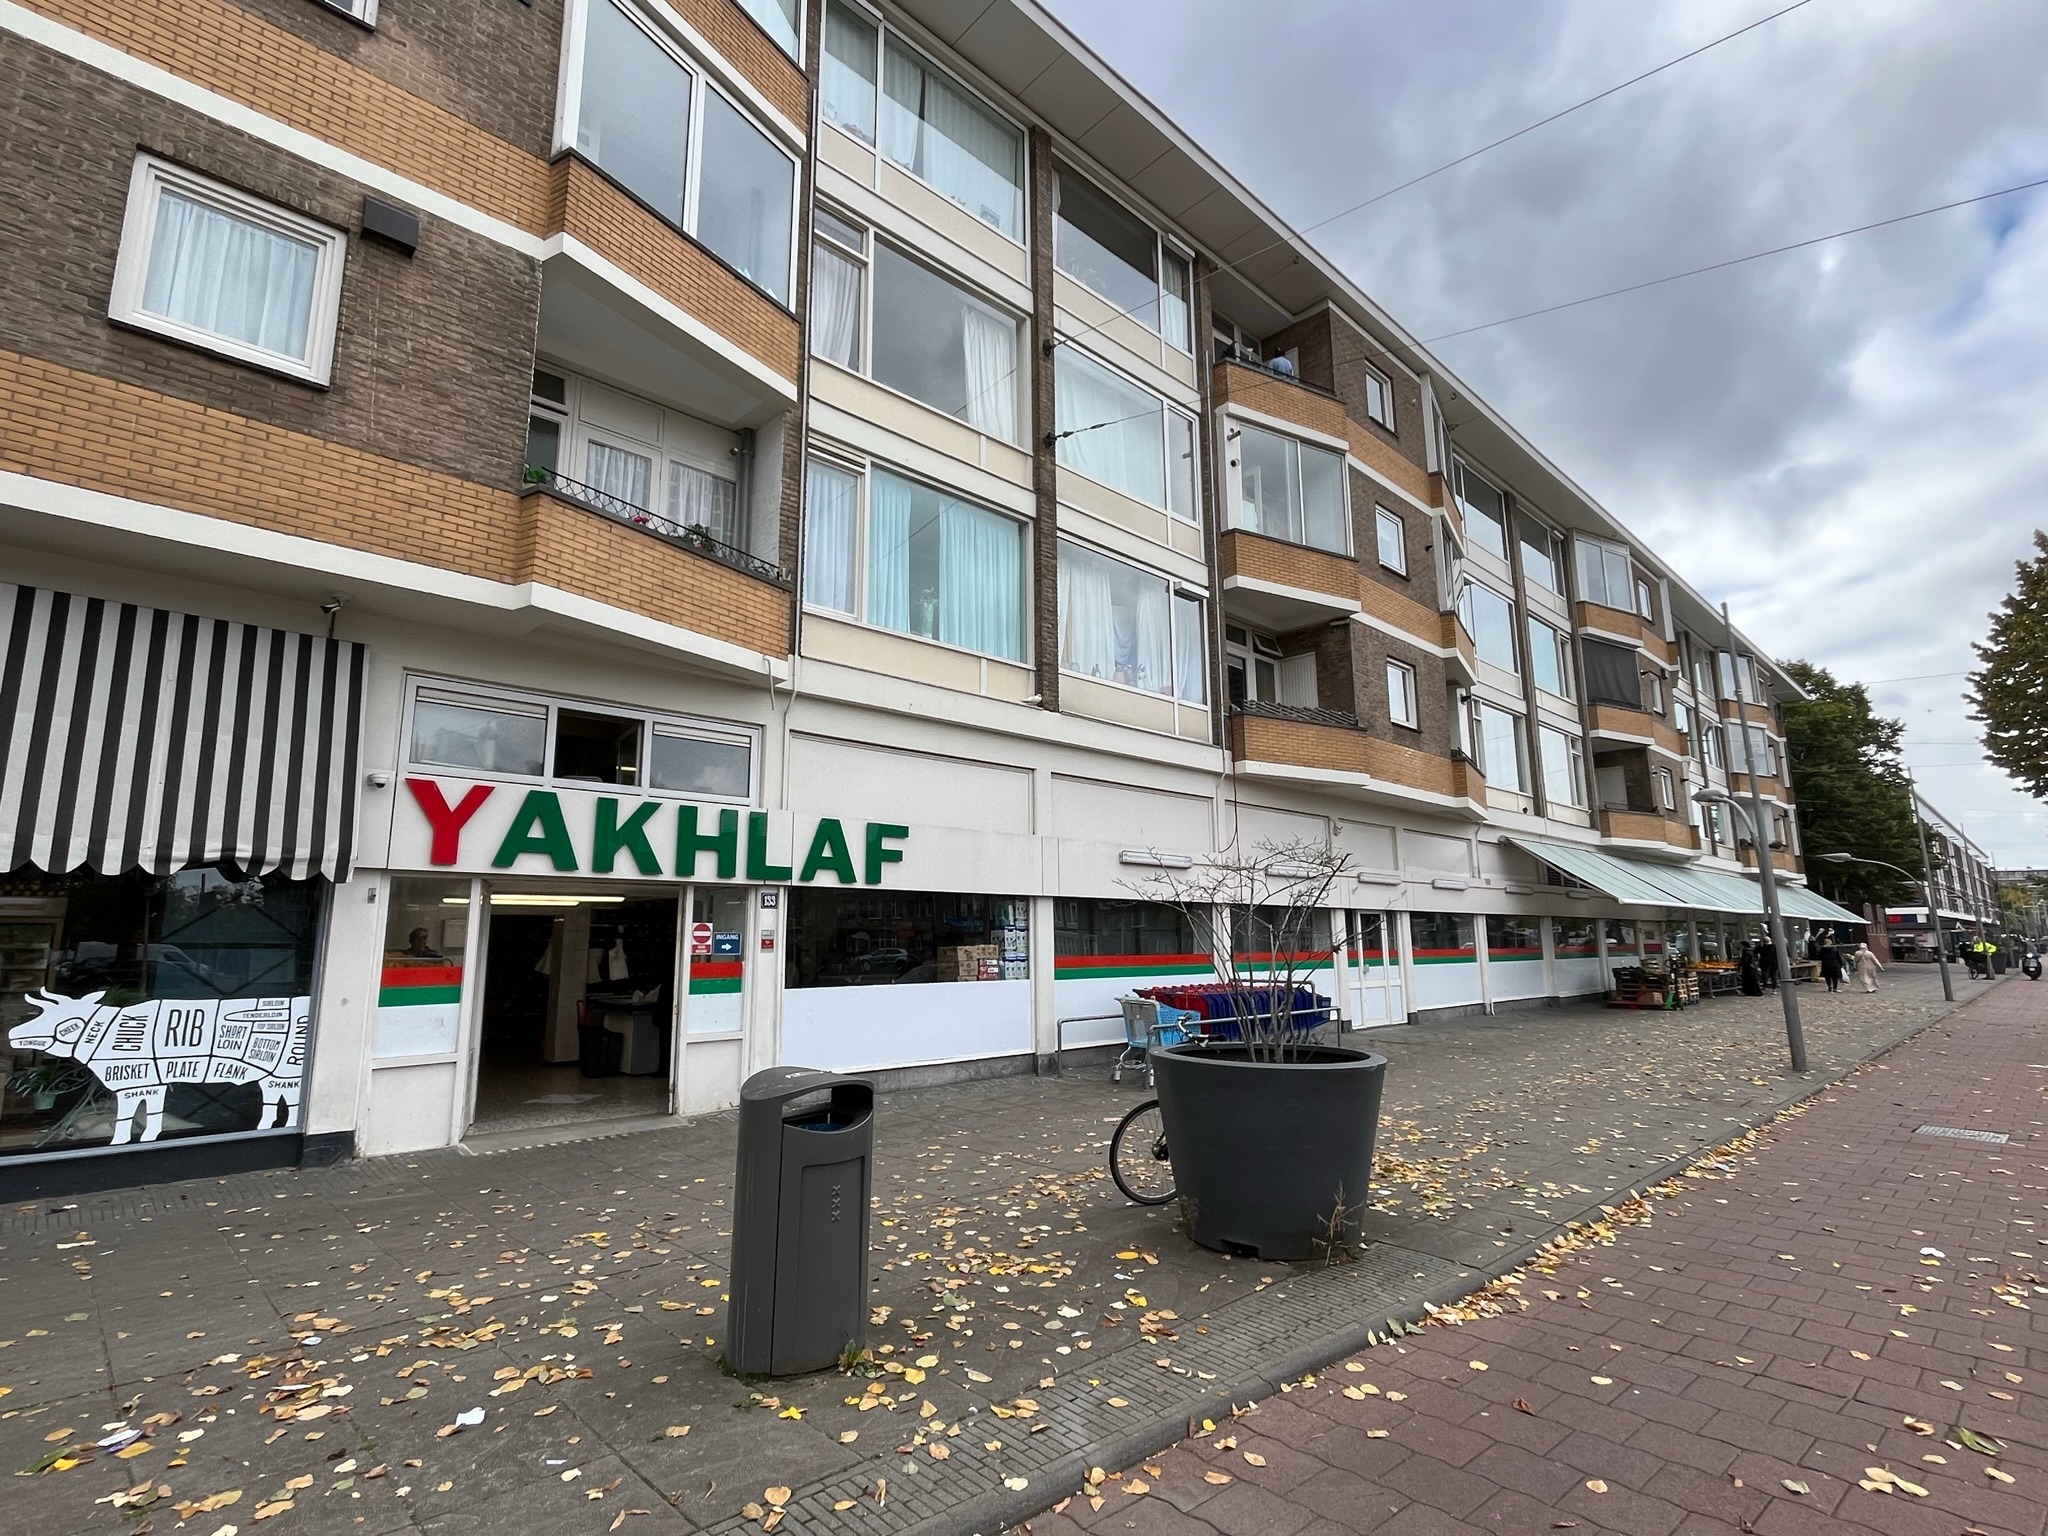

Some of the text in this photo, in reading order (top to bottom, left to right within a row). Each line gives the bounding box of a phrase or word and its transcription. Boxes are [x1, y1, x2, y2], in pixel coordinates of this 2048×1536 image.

[405, 778, 909, 884] YAKHLAF
[59, 1023, 81, 1036] CHEEK
[85, 1020, 104, 1044] NECK
[112, 1014, 149, 1051] CHUCK
[164, 1008, 206, 1048] RIB
[219, 1024, 249, 1040] SHORT
[216, 1039, 243, 1051] LOIN
[252, 1037, 282, 1051] BOTTOM
[286, 1015, 309, 1066] ROUND
[249, 1049, 276, 1063] SIRLOIN
[104, 1062, 151, 1082] BRISKET
[165, 1061, 200, 1079] PLATE
[213, 1063, 249, 1080] FLANK
[268, 1080, 300, 1088] SHANK
[124, 1089, 159, 1099] SHANK
